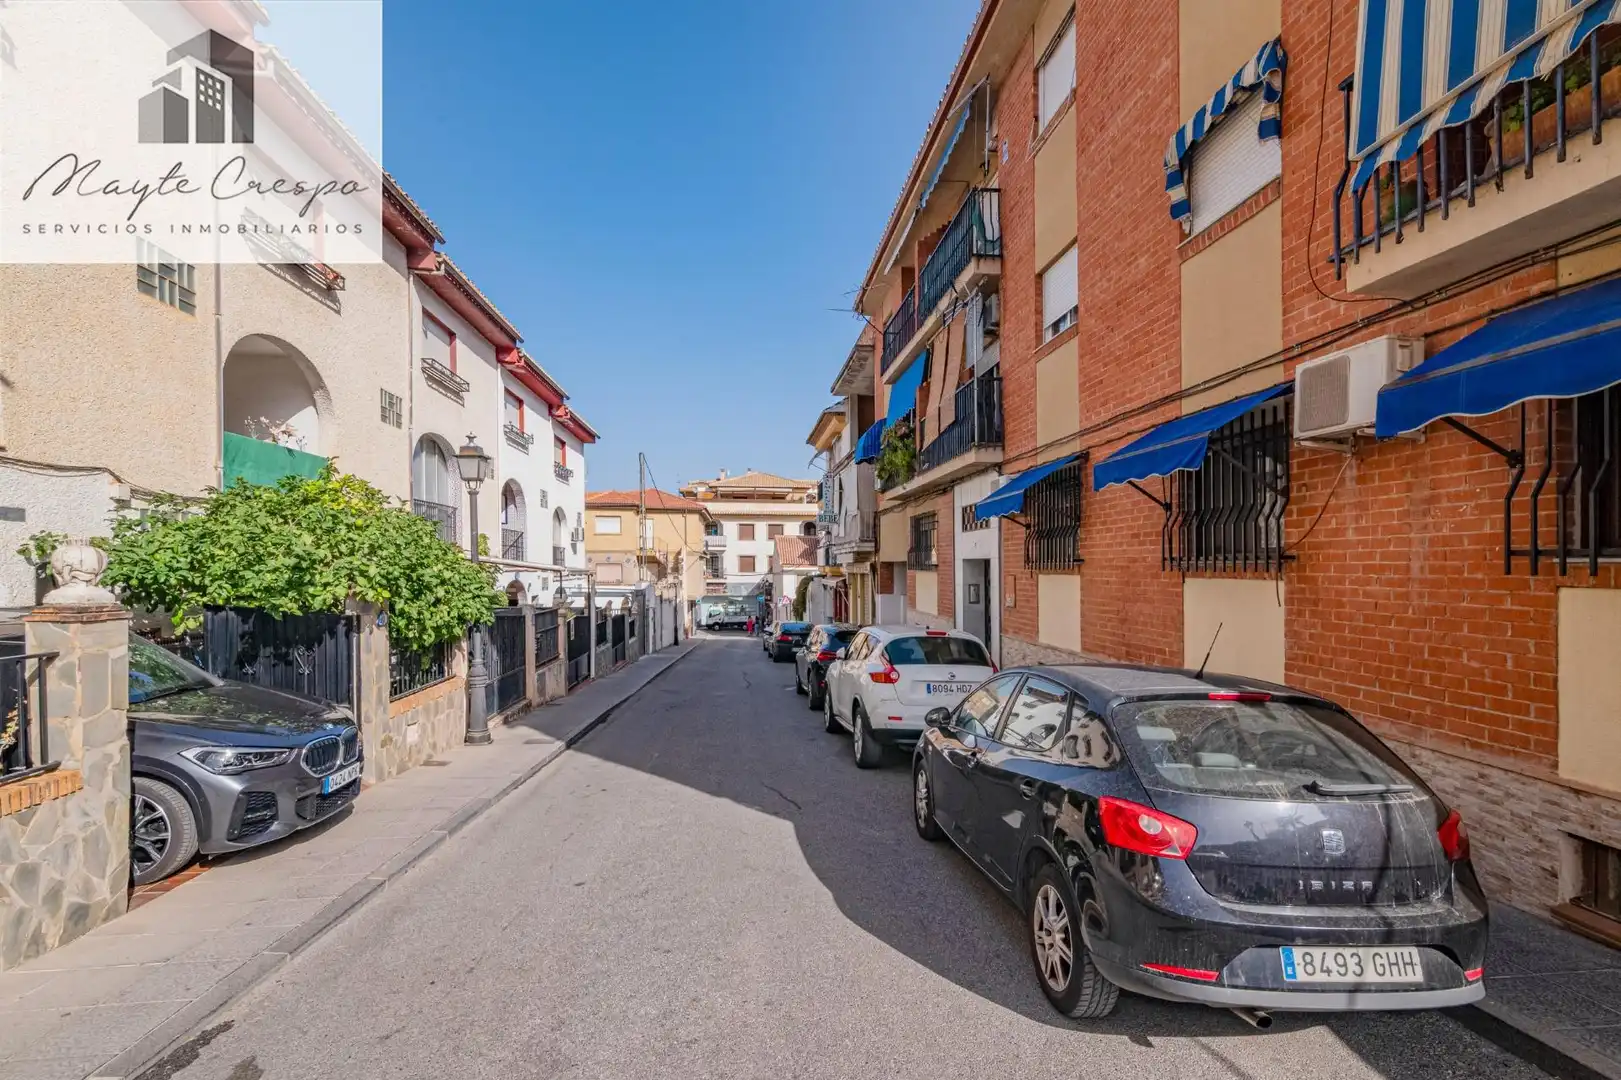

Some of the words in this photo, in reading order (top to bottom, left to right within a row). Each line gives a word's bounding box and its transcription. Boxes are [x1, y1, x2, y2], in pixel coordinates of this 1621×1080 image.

[932, 684, 954, 693] 8094
[1301, 951, 1364, 977] 8493
[1371, 951, 1417, 977] GHH
